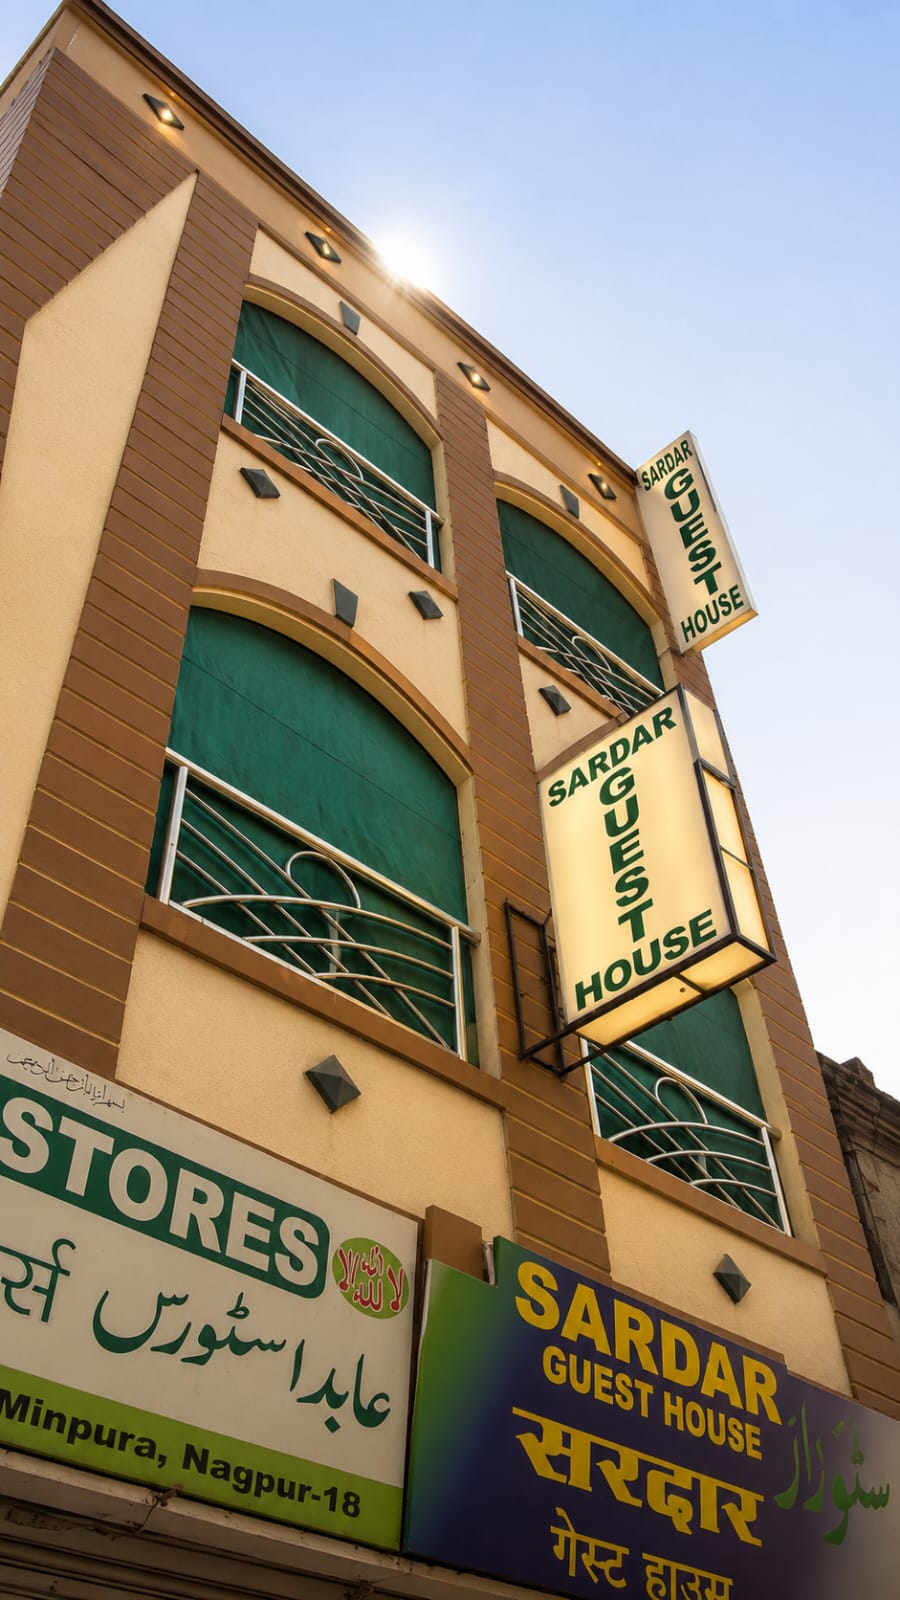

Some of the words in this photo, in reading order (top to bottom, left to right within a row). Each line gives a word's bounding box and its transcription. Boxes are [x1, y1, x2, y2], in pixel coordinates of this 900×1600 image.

[641, 440, 693, 491] SARDAR
[664, 467, 722, 595] GUEST
[681, 584, 744, 643] HOUSE
[547, 707, 677, 807] SARDAR
[599, 767, 653, 943] GUEST
[574, 909, 717, 1012] HOUSE
[0, 1097, 321, 1286] STORES
[514, 1260, 783, 1426] SARDAR
[542, 1345, 654, 1417] GUEST
[663, 1391, 763, 1461] HOUSE
[182, 1442, 362, 1519] Nagpur-18
[511, 1406, 765, 1547] सरदार
[550, 1506, 630, 1589] गेस्ट
